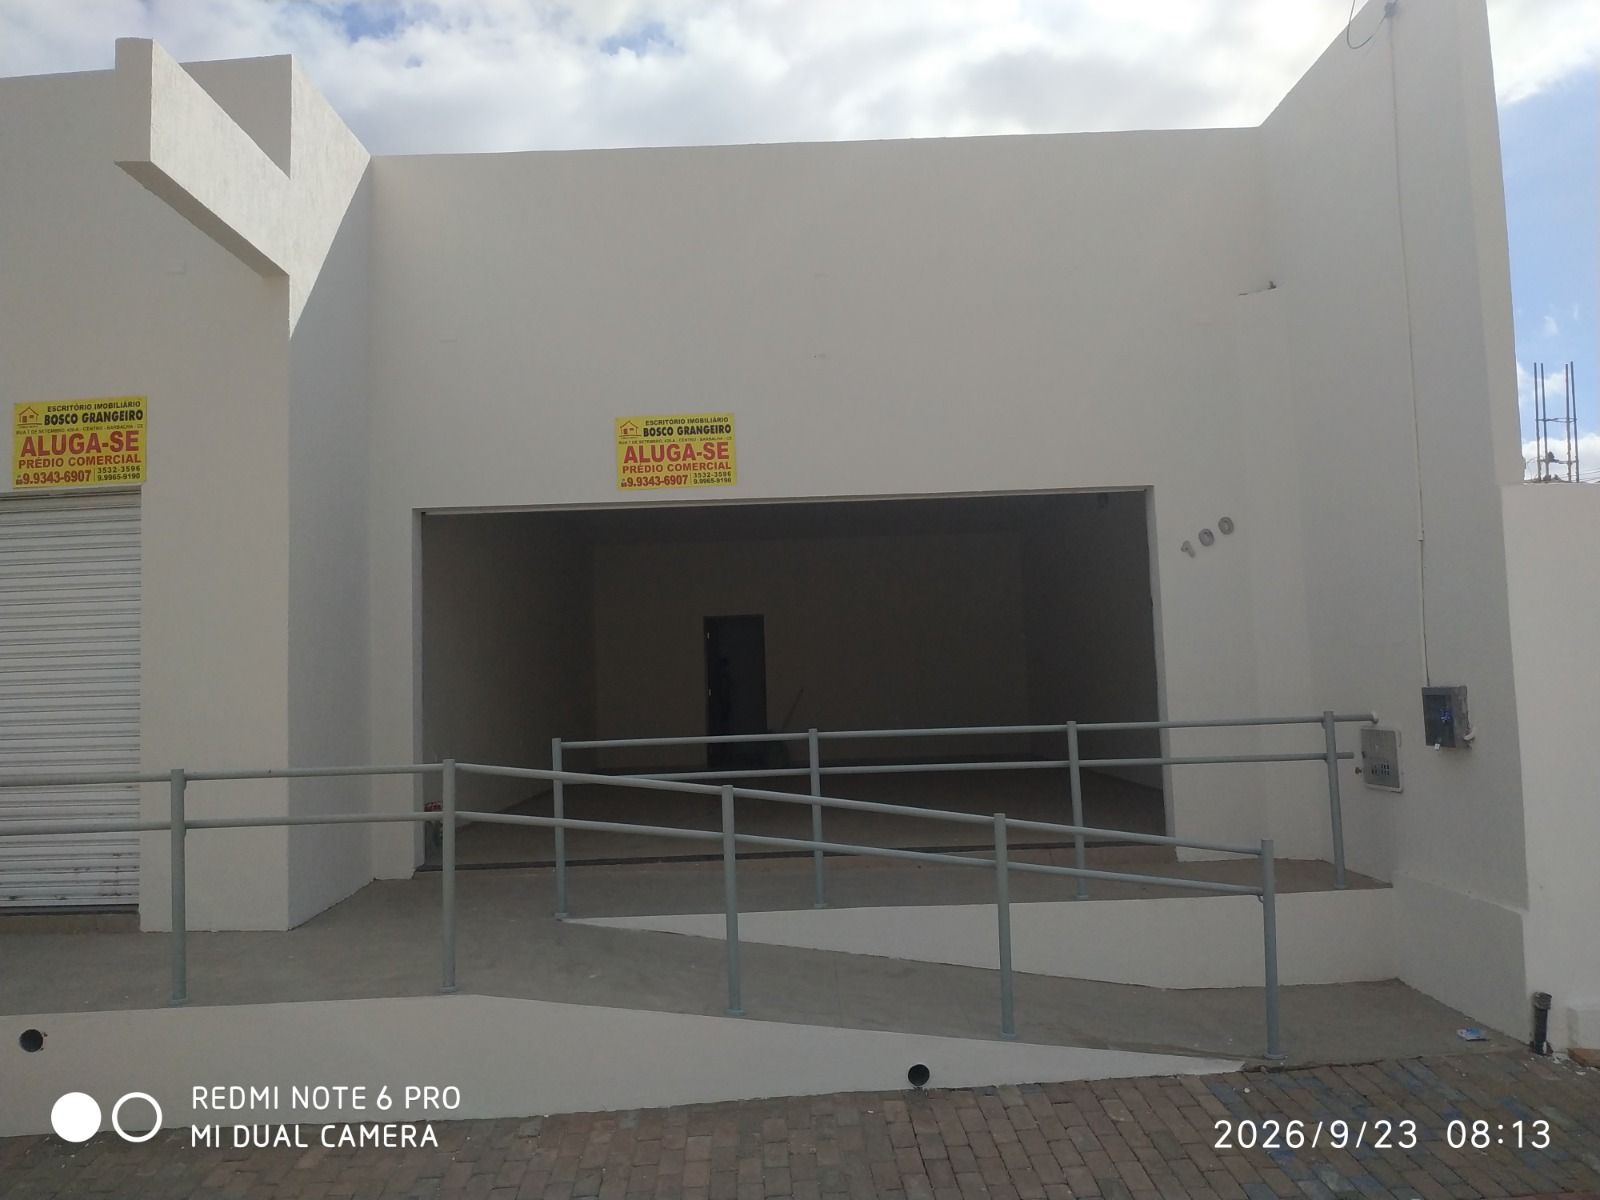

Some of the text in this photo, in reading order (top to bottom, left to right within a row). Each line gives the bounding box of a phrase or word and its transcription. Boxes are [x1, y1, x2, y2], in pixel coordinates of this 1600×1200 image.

[47, 401, 141, 412] ESCRITÓRIO IMOBILIÁRIO
[44, 410, 143, 426] BOSCO GRANGEIRO
[687, 416, 728, 424] IMOBILIÁRIO
[643, 424, 731, 437] BOSCO GRANGEIRO
[20, 430, 139, 457] ALUGA-SE
[624, 442, 730, 464] ALUGA-SE
[18, 454, 141, 469] PRÉDIO COMERCIAL
[622, 462, 732, 474] PRÉDIO COMERCIAL
[22, 470, 91, 485] 9.9343-6907
[627, 475, 688, 487] 9.9343-6907
[1180, 516, 1235, 559] 100
